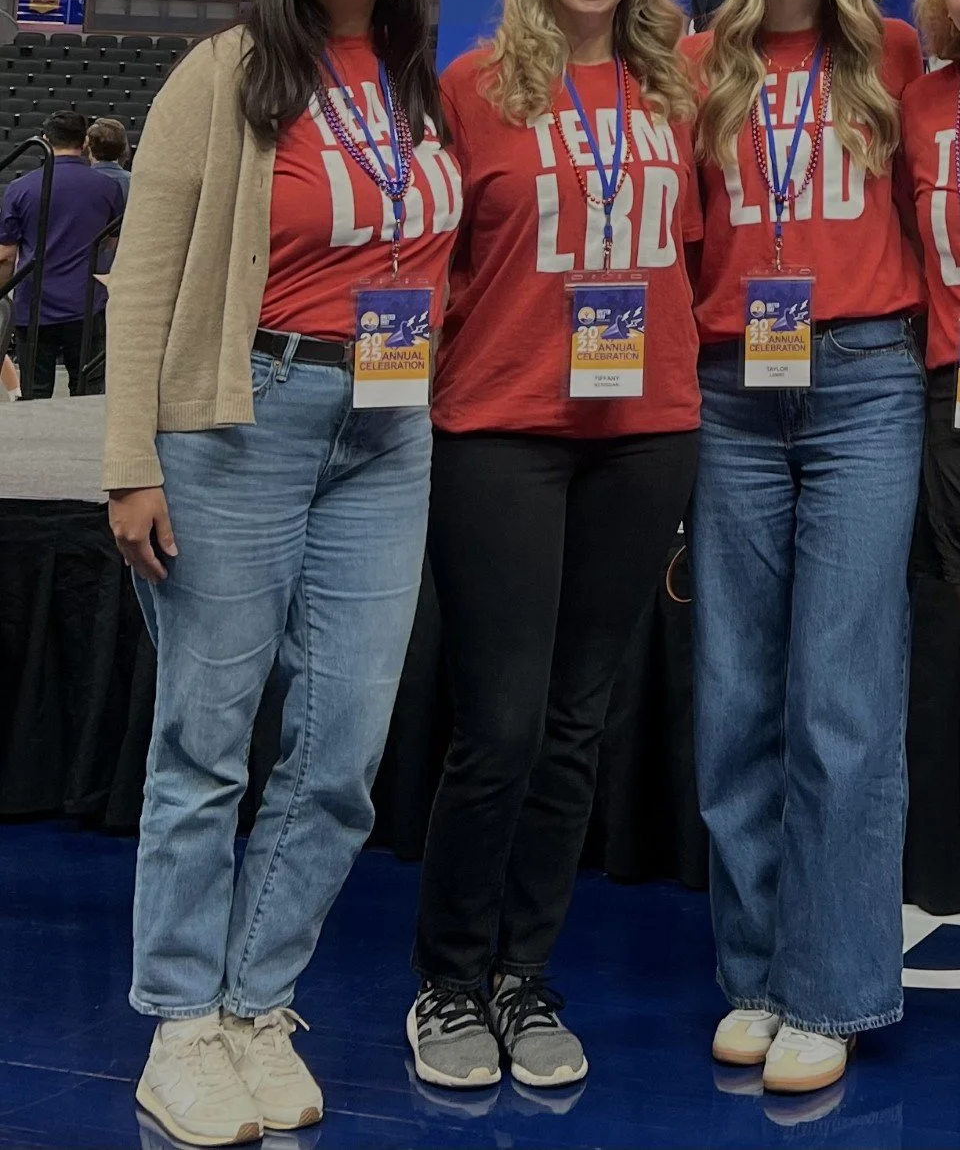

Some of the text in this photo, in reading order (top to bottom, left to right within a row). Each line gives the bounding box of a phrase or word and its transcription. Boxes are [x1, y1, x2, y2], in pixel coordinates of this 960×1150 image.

[526, 107, 680, 169] TEAM
[722, 125, 866, 227] LRD
[535, 165, 680, 274] LRD
[749, 318, 769, 331] 20
[577, 325, 599, 339] 20
[360, 332, 382, 347] 20
[768, 335, 805, 344] ANNUAL
[598, 342, 637, 352] ANNUAL
[749, 343, 806, 352] CELEBRATION
[381, 351, 425, 361] ANNUAL
[576, 352, 639, 361] CELEBRATION
[359, 361, 425, 371] CELEBRATION
